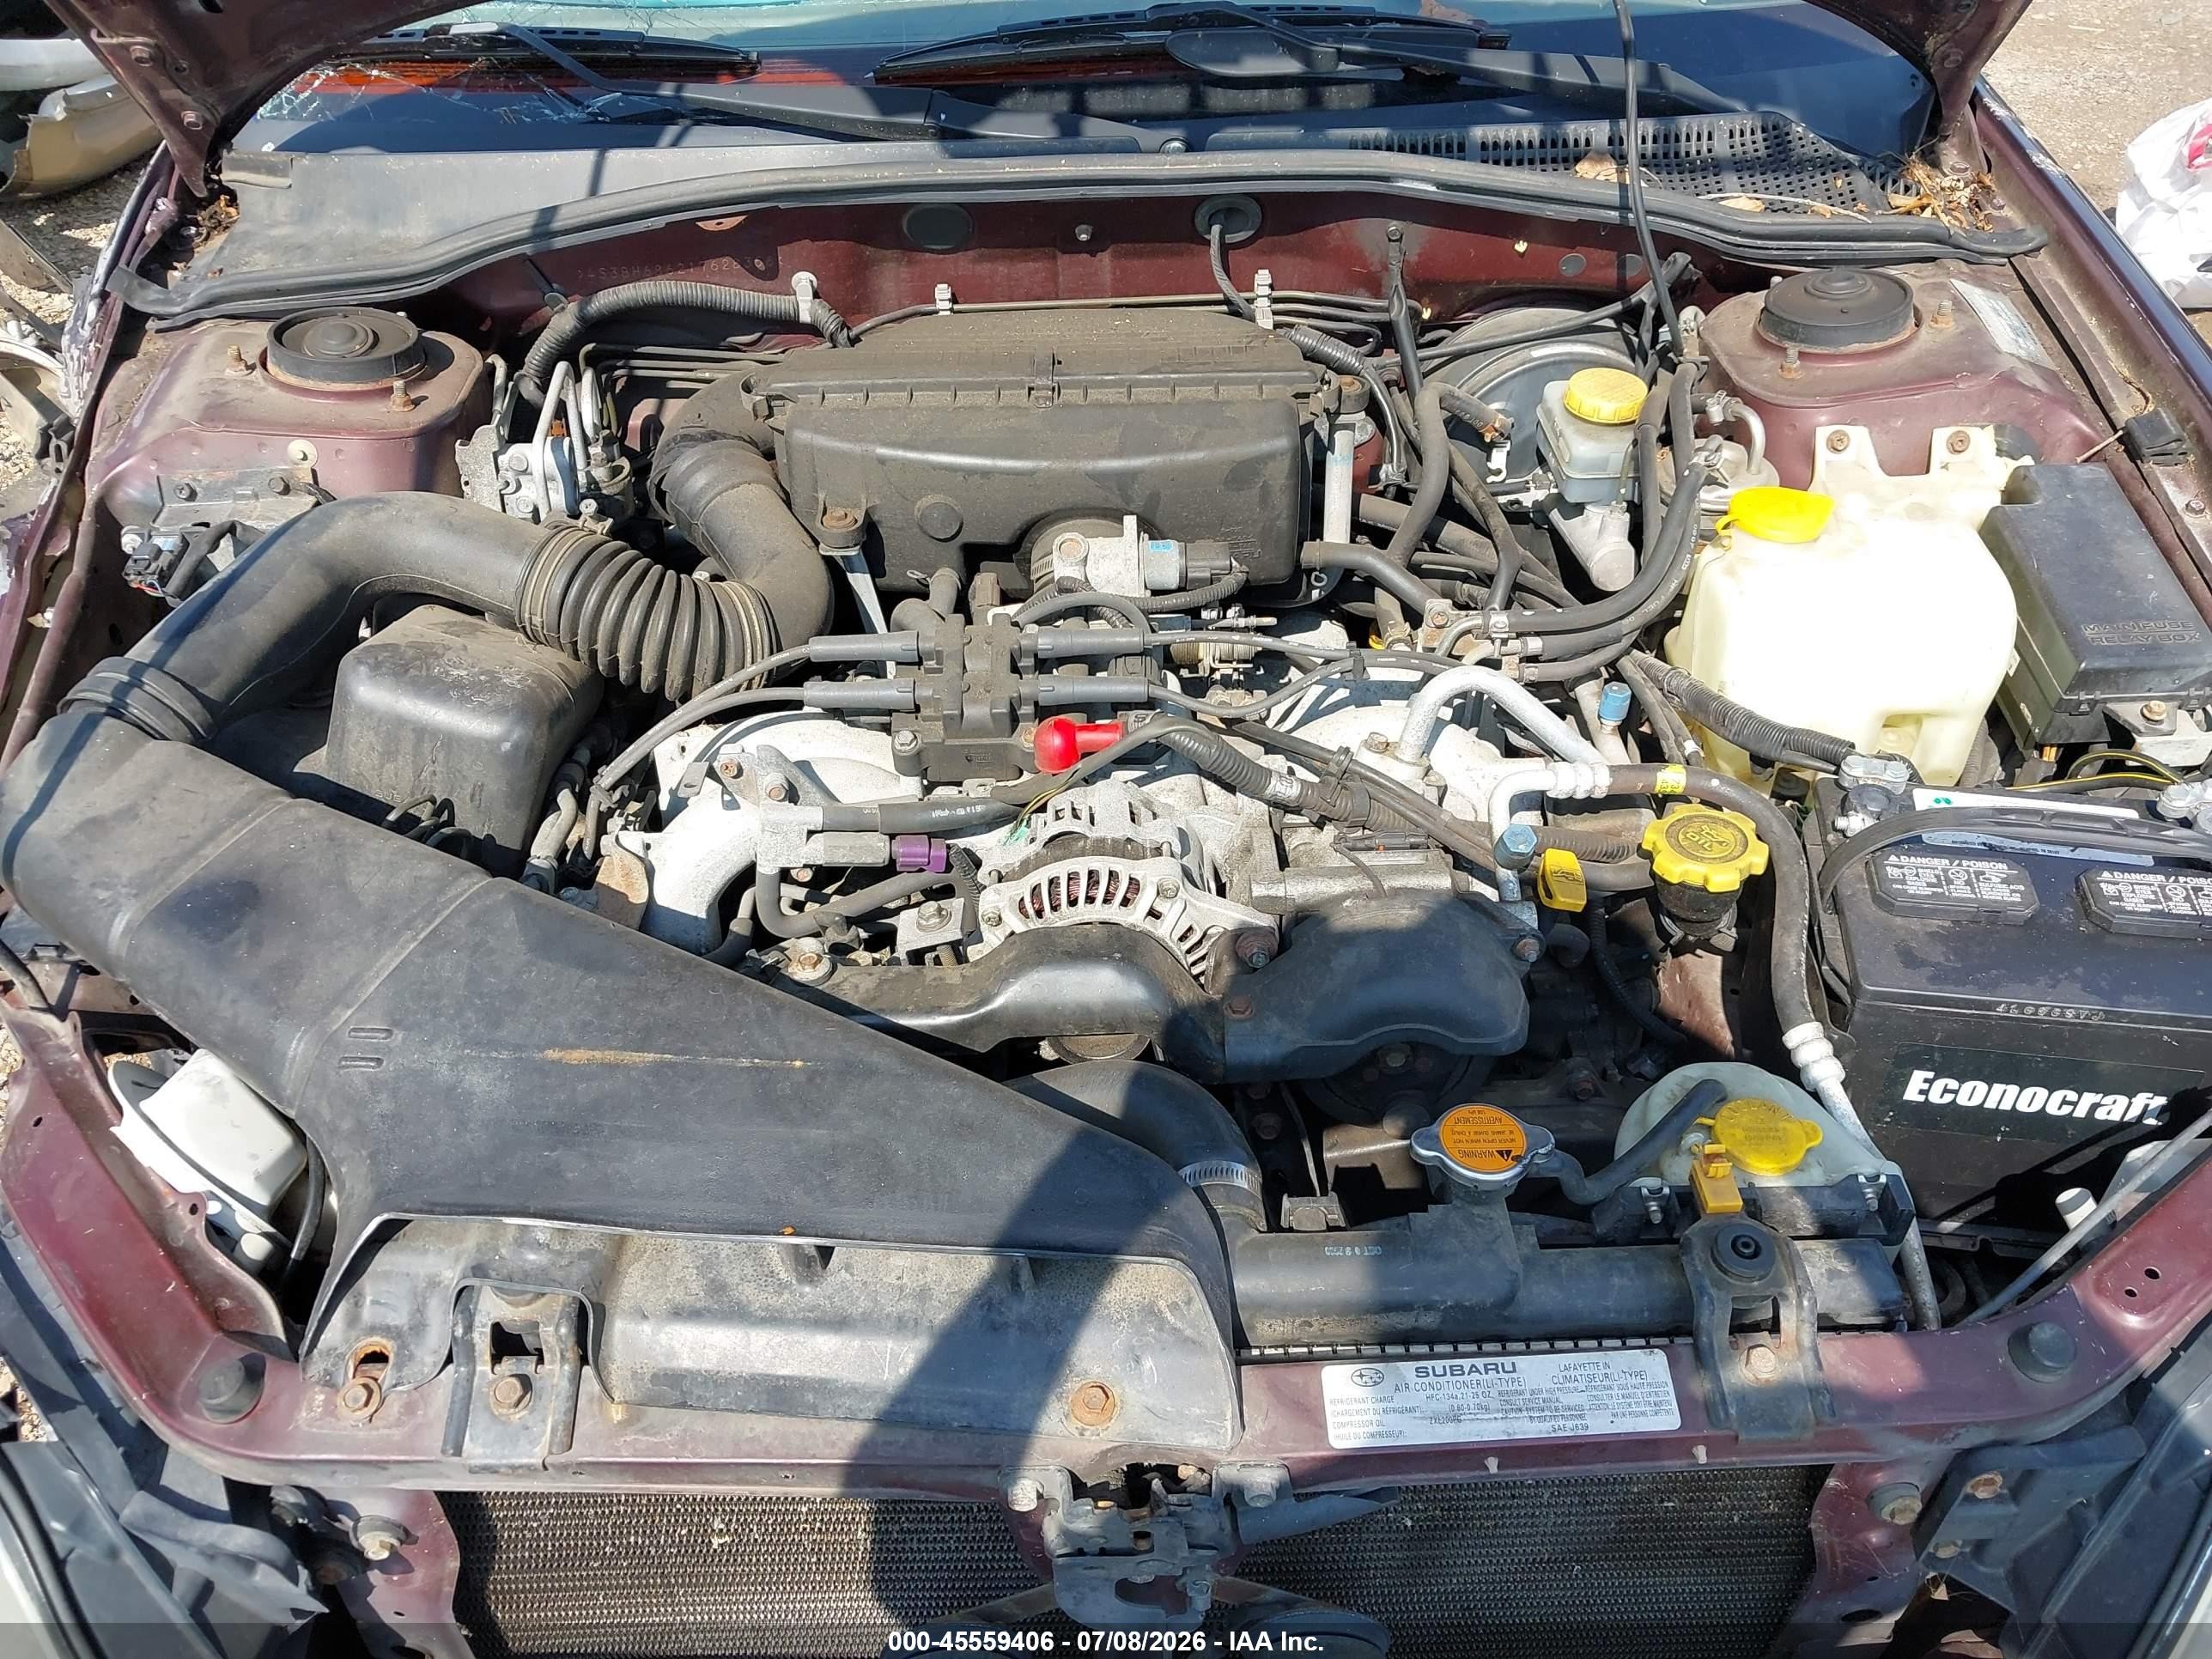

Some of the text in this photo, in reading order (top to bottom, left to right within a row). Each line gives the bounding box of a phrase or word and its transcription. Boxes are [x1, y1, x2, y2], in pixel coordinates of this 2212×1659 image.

[2082, 620, 2196, 633] MAIN FUSE
[2088, 632, 2202, 644] RELAY BOX
[1686, 831, 1713, 851] OIL
[1900, 856, 1950, 866] DANGER
[1962, 860, 2008, 870] POISON
[2113, 872, 2166, 883] DANGER
[1903, 1069, 2167, 1126] Econocraft
[1457, 1149, 1496, 1158] WARNING
[1415, 1361, 1516, 1378] SUBARU
[1559, 1361, 1611, 1372] LAFAYETTE IN
[1552, 1370, 1648, 1385] CLIMATISEUR(LI-TYPE)
[1394, 1376, 1526, 1393] AIR CONDITIONER(LI-TYPE)
[1646, 1381, 1668, 1389] PRESSION
[1528, 1387, 1544, 1396] UNDER
[1587, 1393, 1613, 1401] CONSULTER
[1621, 1391, 1640, 1400] MANUEL
[1370, 1395, 1395, 1404] CHARGE
[1522, 1397, 1540, 1406] SERVICE
[1333, 1419, 1374, 1429] COMPRESSOR
[1552, 1422, 1589, 1432] SAE J639
